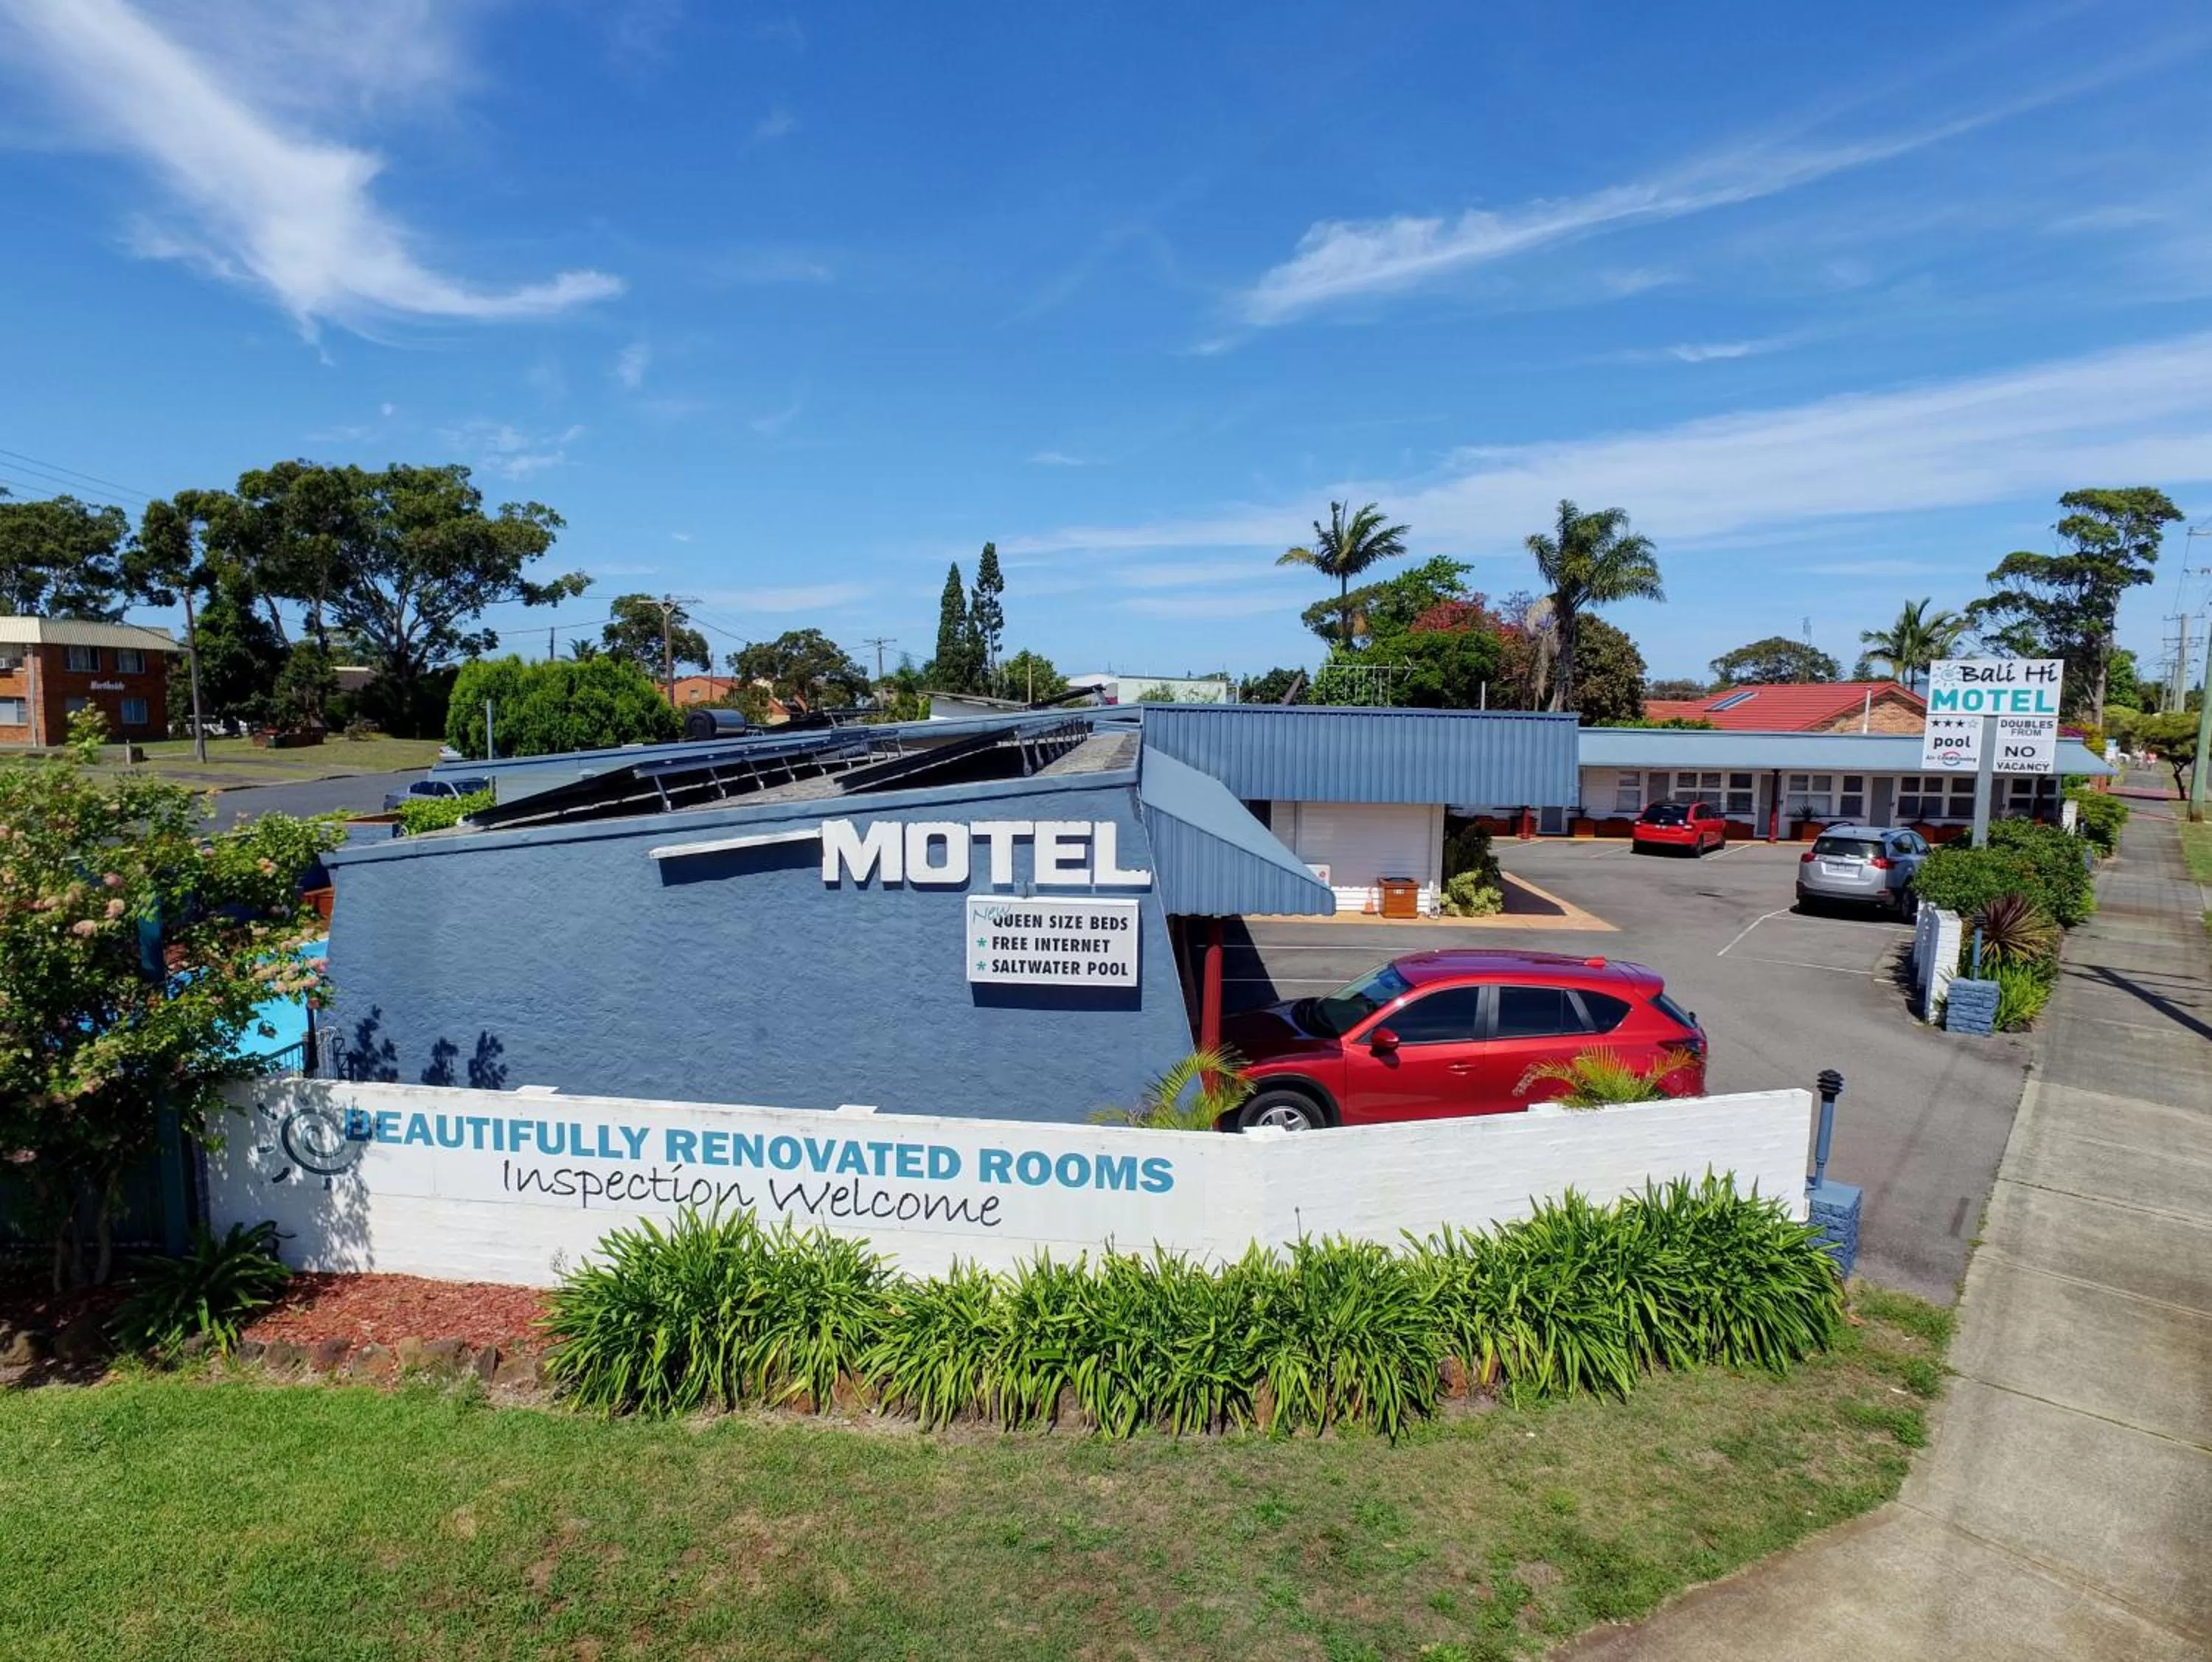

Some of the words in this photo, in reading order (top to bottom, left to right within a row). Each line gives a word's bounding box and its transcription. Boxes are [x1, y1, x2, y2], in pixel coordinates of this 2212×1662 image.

[1960, 663, 2016, 683] Bali
[2025, 662, 2058, 683] Hi
[1932, 689, 2054, 712] MOTEL
[2000, 719, 2053, 729] DOUBLES
[2011, 728, 2042, 736] FROM
[1933, 735, 1971, 749] pool
[2005, 745, 2036, 757] NO
[1997, 762, 2050, 771] VACANCY
[821, 818, 1152, 886] MOTEL
[973, 903, 1012, 925] New
[992, 914, 1043, 928] QUEEN
[1049, 915, 1082, 929] SIZE
[1090, 917, 1128, 931] BEDS
[992, 936, 1028, 950] FREE
[1034, 937, 1111, 953] INTERNET
[992, 959, 1080, 976] SALTWATER
[1088, 962, 1129, 976] POOL
[345, 1108, 650, 1161] BEAUTIFULLY
[665, 1127, 962, 1180] RENOVATED
[978, 1148, 1175, 1194] ROOMS
[502, 1158, 755, 1209] Inspection
[769, 1178, 1002, 1226] Welcome
